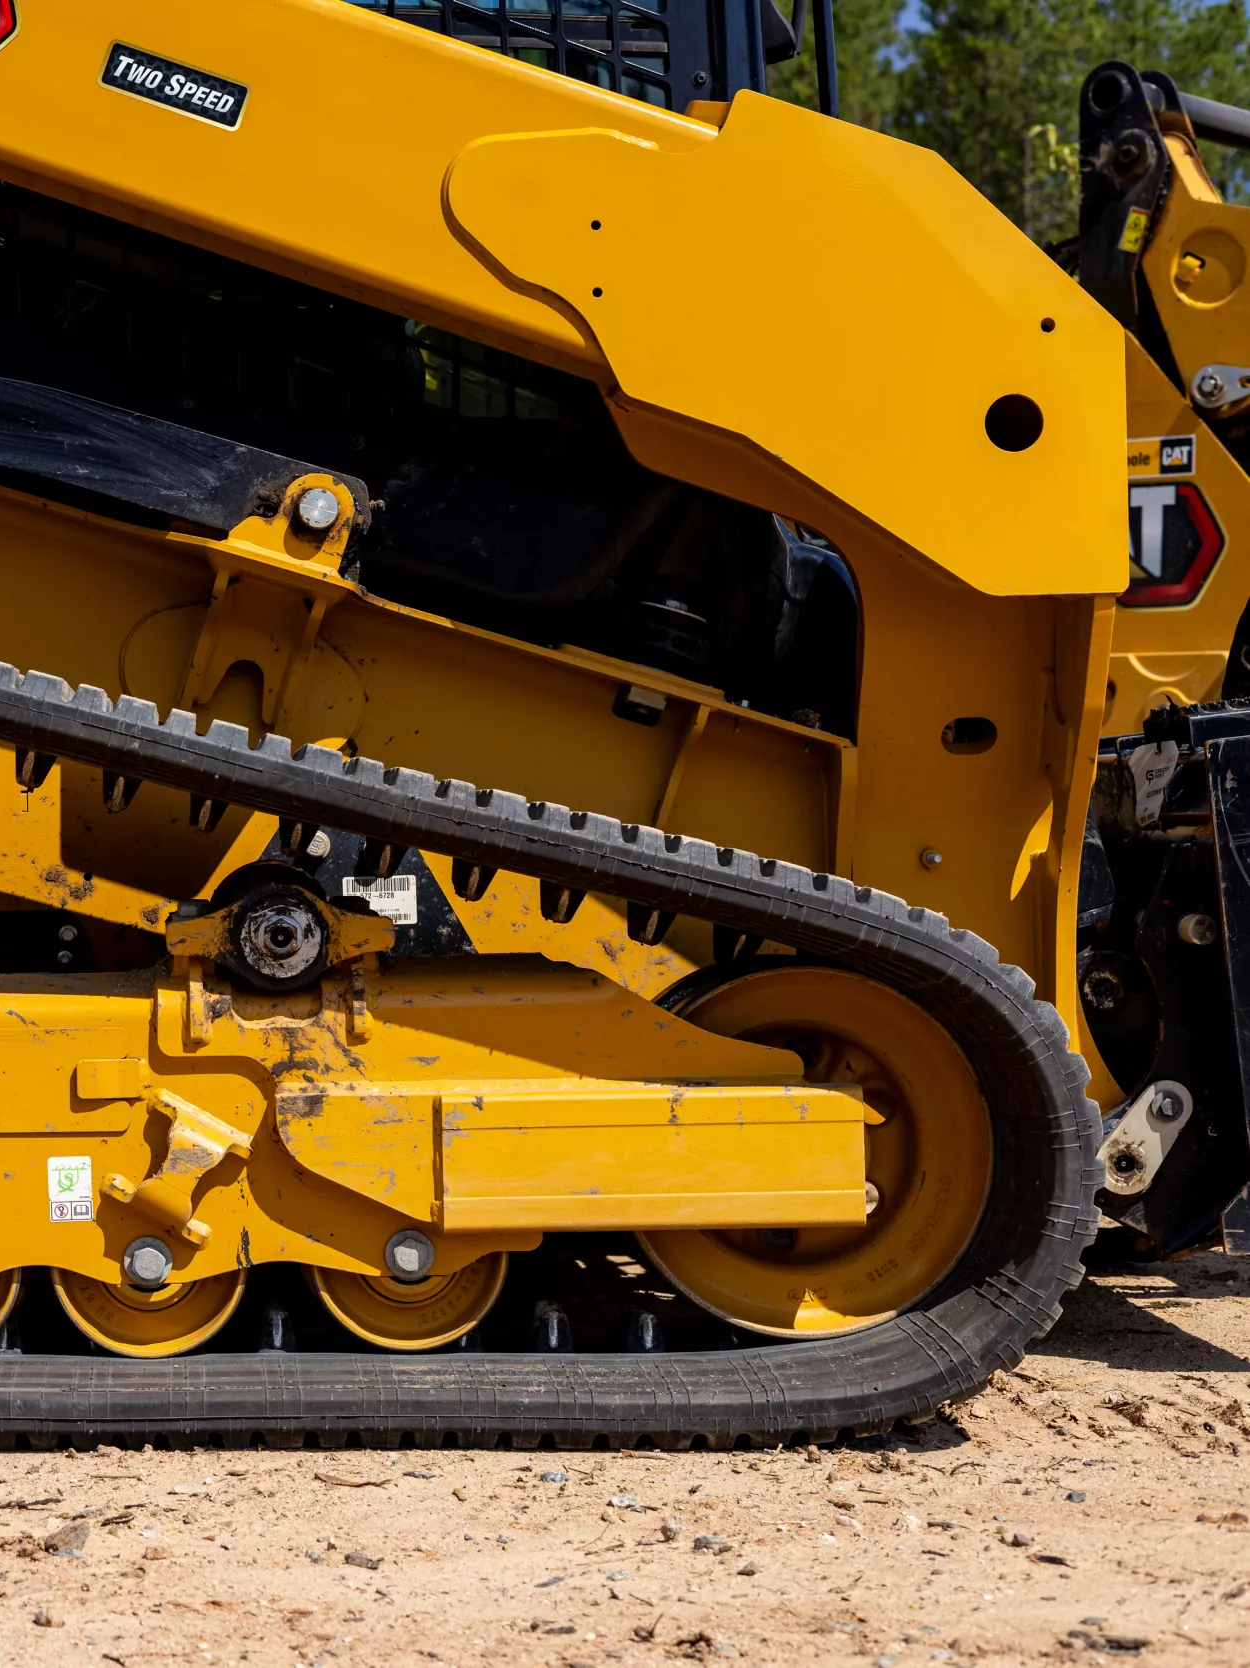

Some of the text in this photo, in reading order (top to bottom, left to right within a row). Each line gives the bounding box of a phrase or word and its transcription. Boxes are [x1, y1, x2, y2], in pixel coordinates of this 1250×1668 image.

[113, 55, 235, 113] TWO SPEED
[1128, 445, 1191, 467] ole CAT
